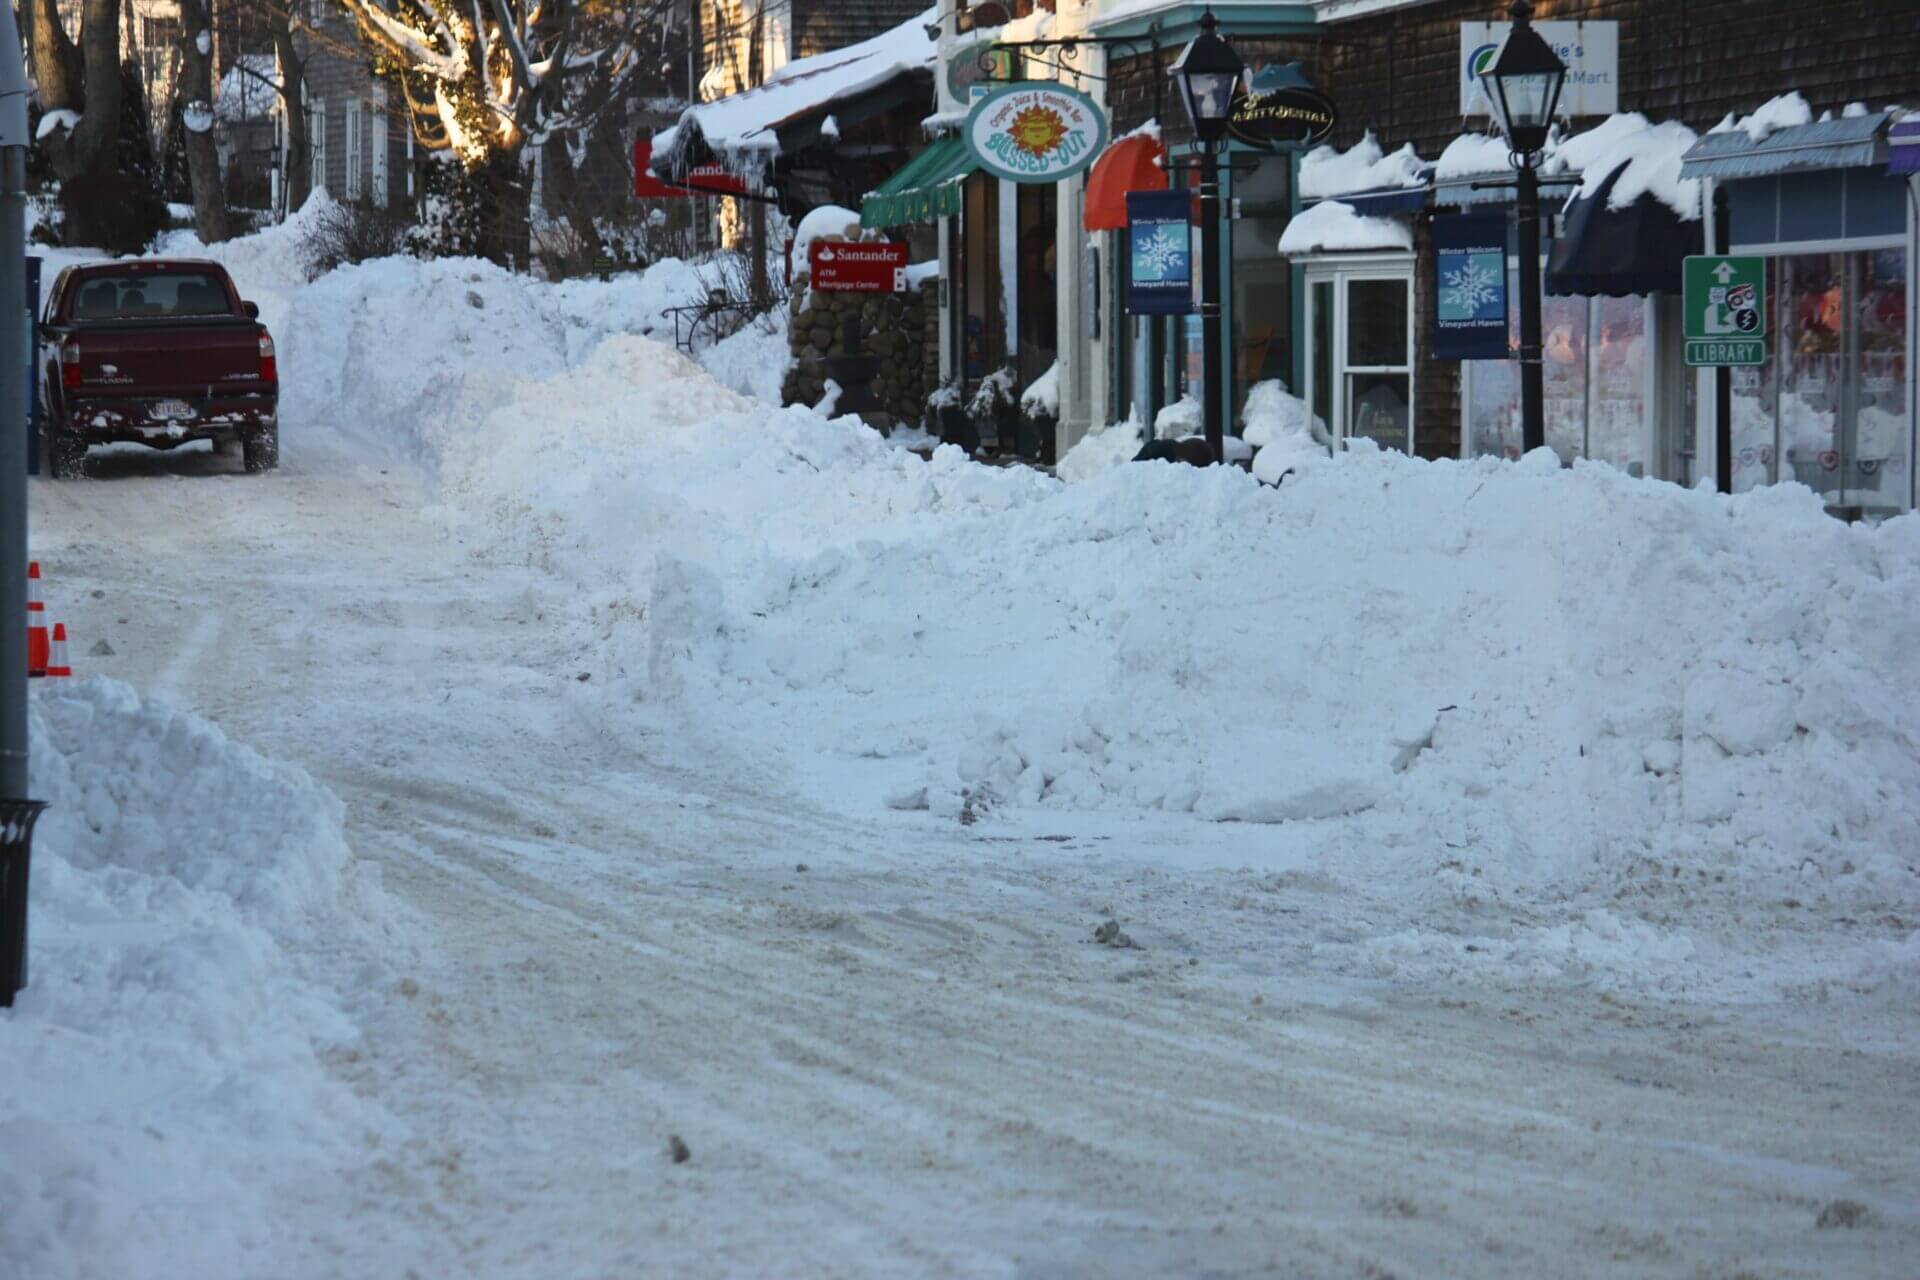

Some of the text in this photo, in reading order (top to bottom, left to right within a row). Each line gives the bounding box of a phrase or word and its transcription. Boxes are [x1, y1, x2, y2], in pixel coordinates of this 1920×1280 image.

[836, 247, 899, 261] Santander
[1466, 246, 1503, 254] Welcome
[819, 268, 837, 277] ATM
[819, 281, 880, 290] Mortgage Center
[1132, 280, 1165, 289] Vineyard
[1439, 319, 1505, 329] Vineyard Haven
[1694, 343, 1756, 362] LIBRARY
